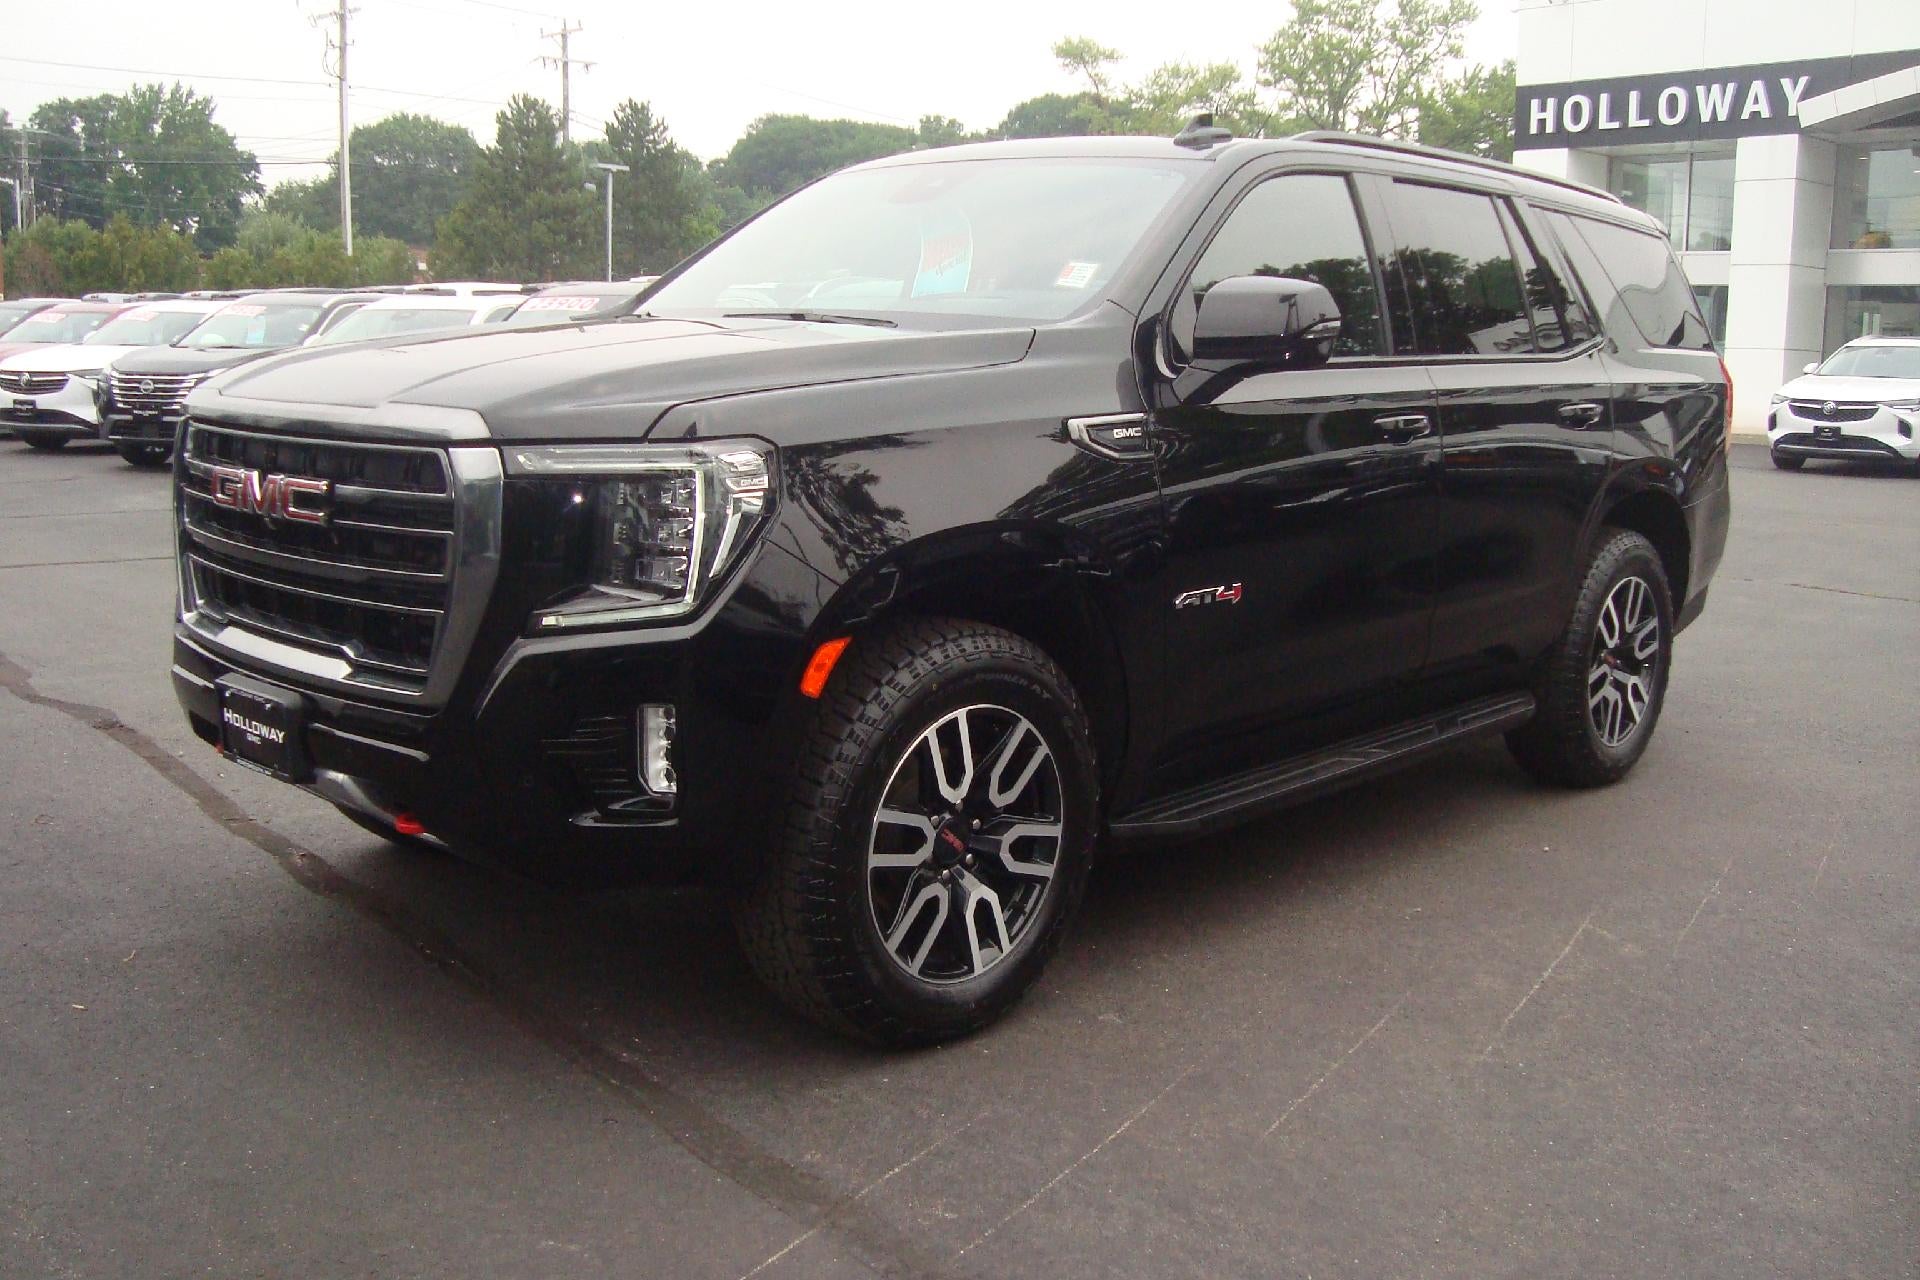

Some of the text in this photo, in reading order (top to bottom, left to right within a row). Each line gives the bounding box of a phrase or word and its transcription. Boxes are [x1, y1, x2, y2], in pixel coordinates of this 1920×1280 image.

[1529, 76, 1810, 135] HOLLOWAY
[1113, 427, 1142, 439] GMC
[211, 467, 329, 526] GMC
[1174, 582, 1243, 609] AT4
[223, 707, 286, 744] HOLLOWAY
